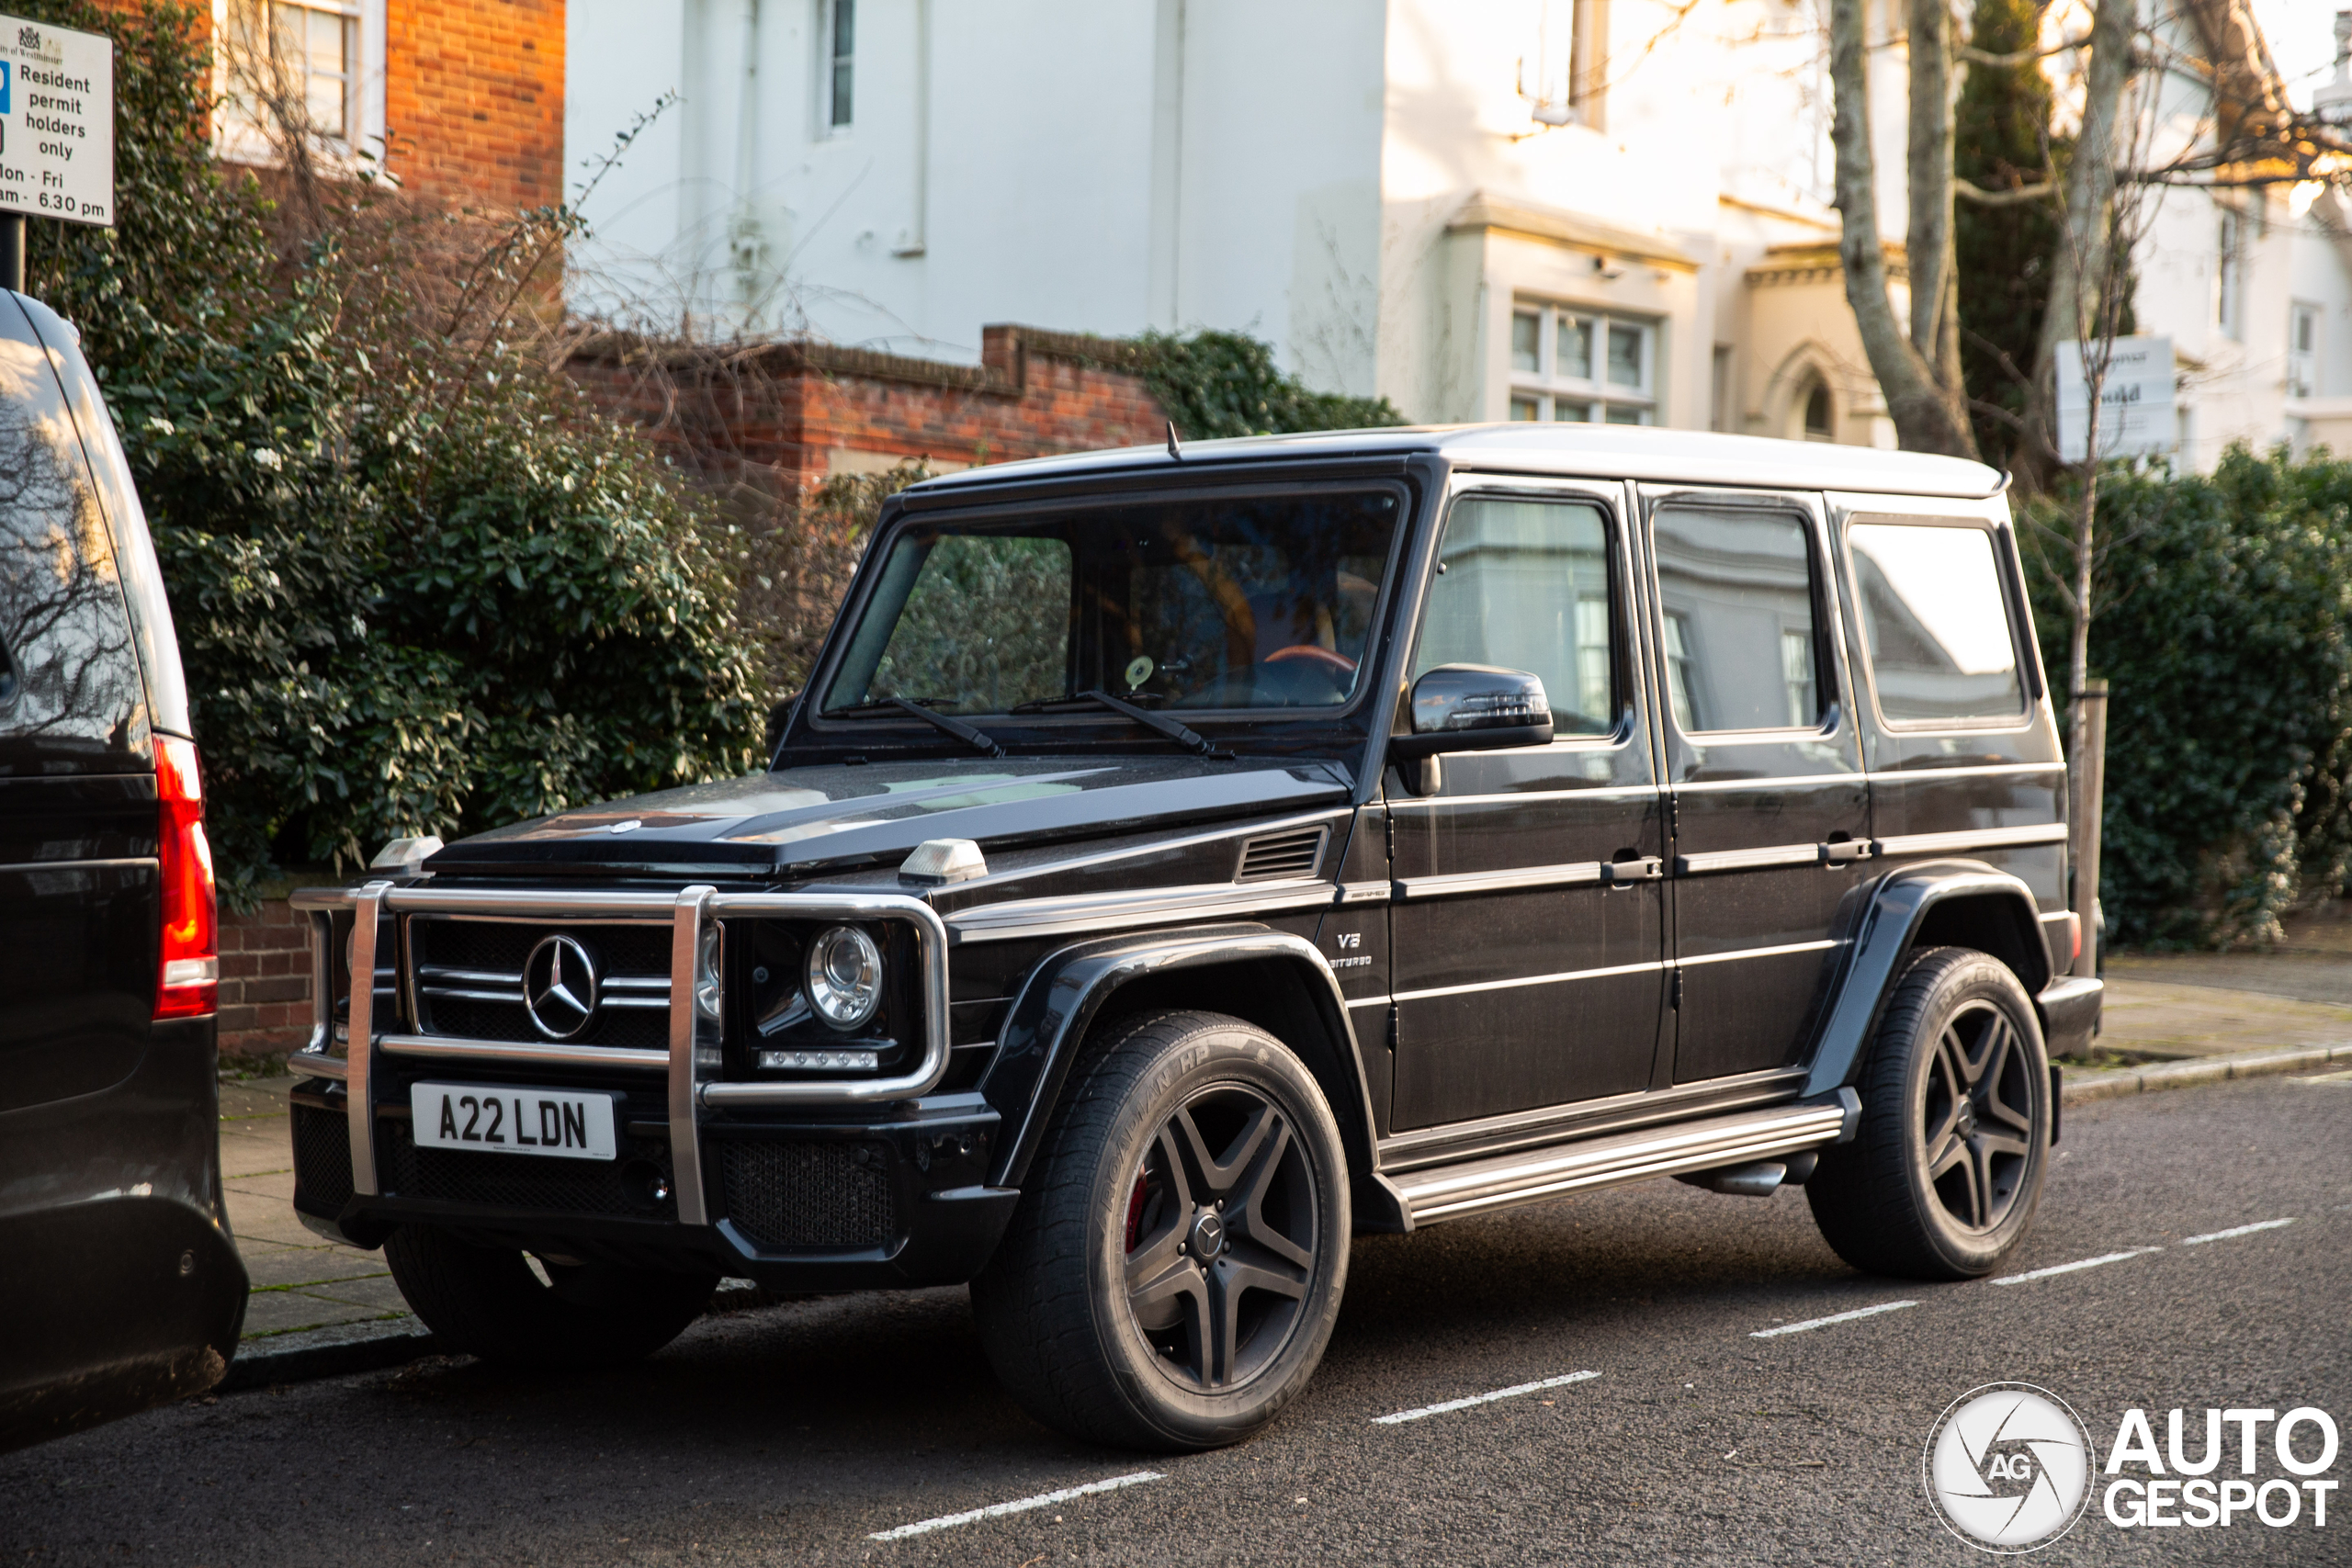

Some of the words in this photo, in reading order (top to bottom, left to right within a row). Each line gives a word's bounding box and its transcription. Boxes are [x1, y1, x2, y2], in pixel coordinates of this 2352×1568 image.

[11, 47, 18, 55] of
[19, 49, 63, 65] Westminster
[20, 63, 91, 94] Resident
[29, 93, 82, 115] permit
[26, 111, 85, 138] holders
[39, 141, 73, 162] only
[42, 170, 63, 188] Fri
[39, 192, 75, 212] 6.30
[82, 203, 105, 217] pm
[1337, 932, 1362, 950] V8
[1329, 955, 1373, 969] BITURBO
[439, 1093, 505, 1144] A22
[514, 1098, 588, 1149] LDN
[1100, 1068, 1173, 1213] ROADIAN
[1179, 1046, 1212, 1076] HP
